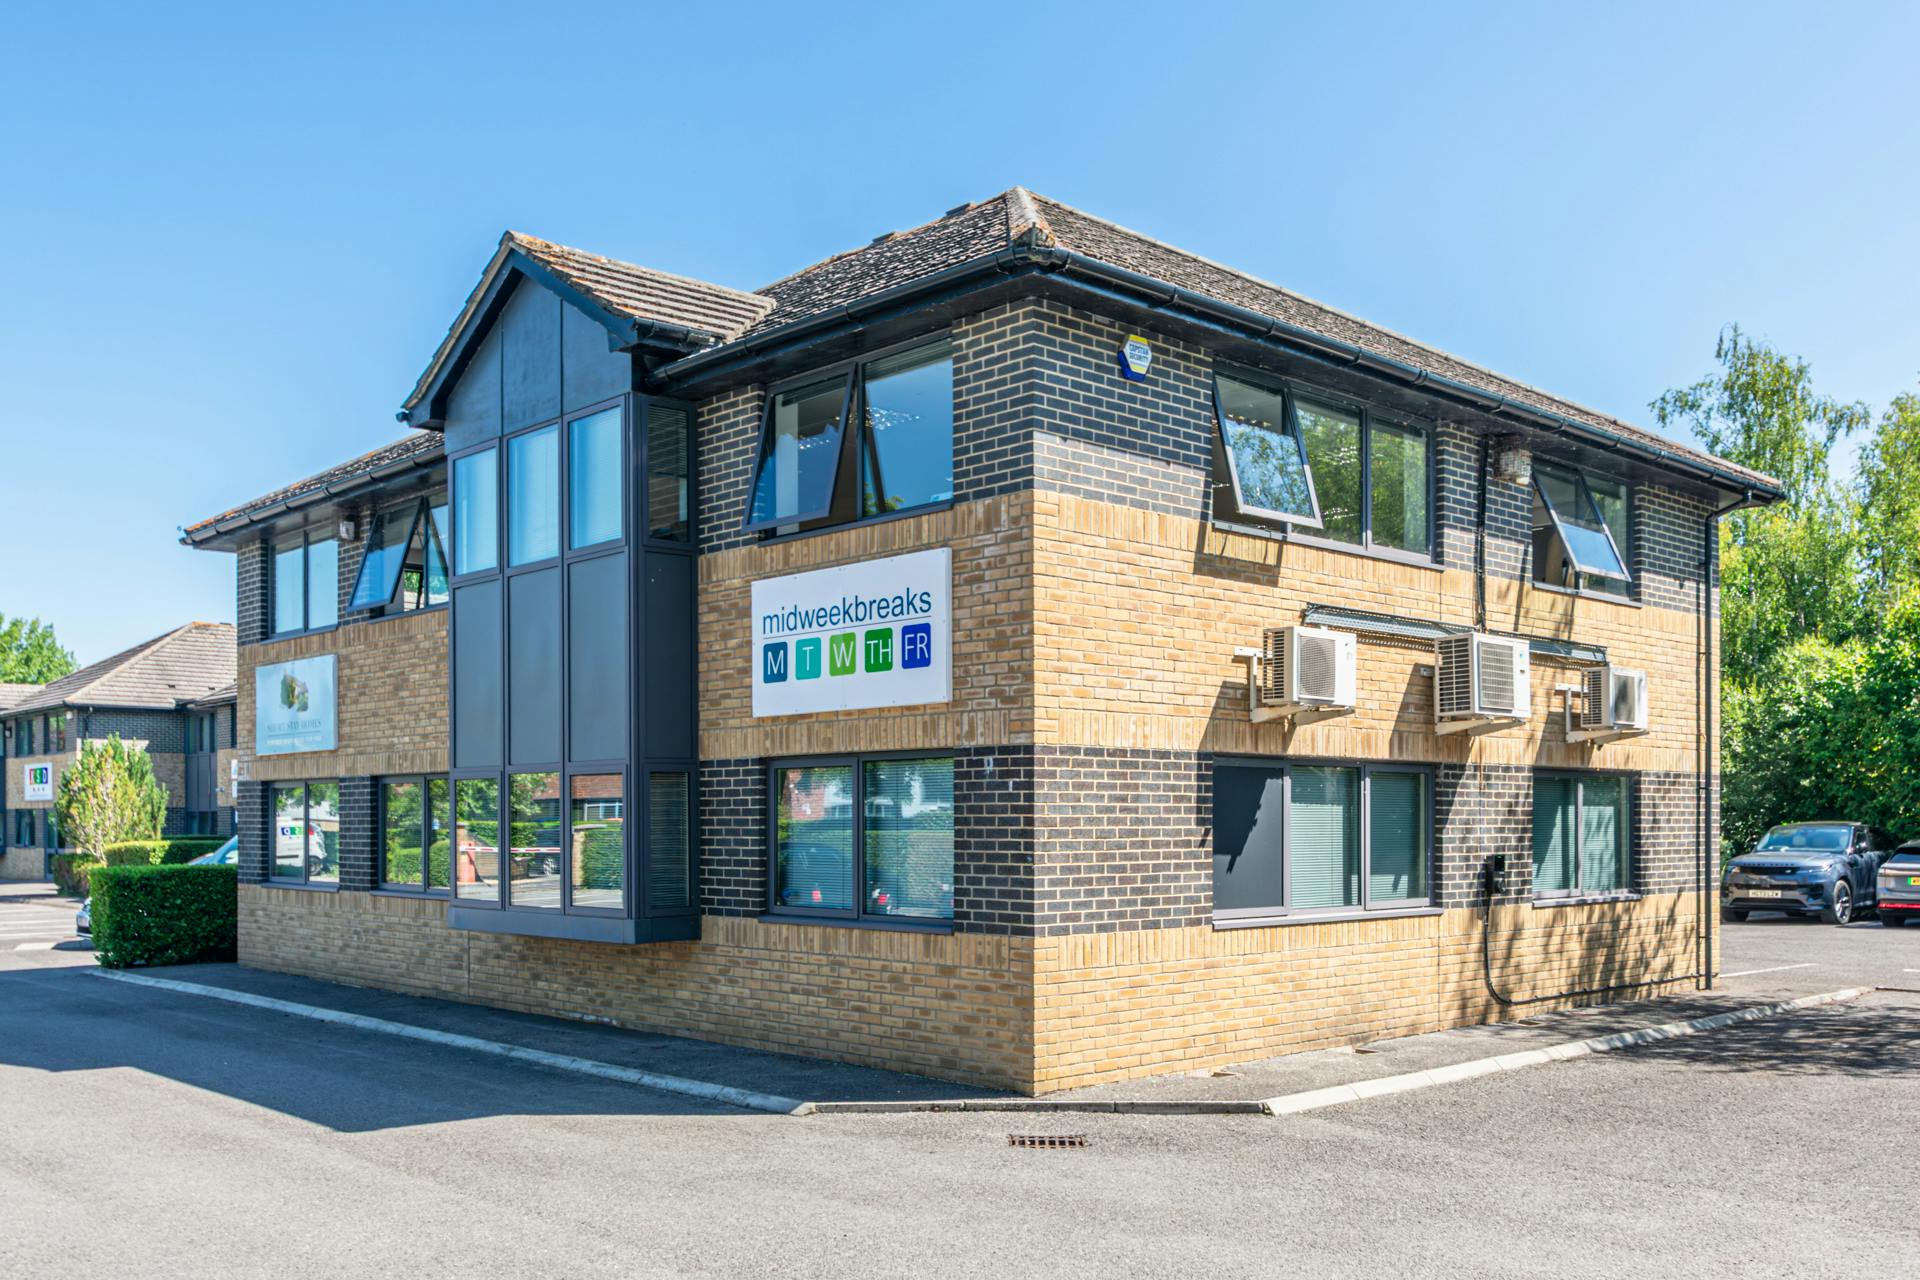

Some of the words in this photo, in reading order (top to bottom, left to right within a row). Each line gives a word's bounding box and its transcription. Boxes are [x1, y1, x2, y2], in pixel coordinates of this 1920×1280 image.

[763, 587, 931, 635] midweekbreaks
[767, 649, 784, 676] M
[802, 646, 814, 672] T
[832, 641, 854, 669] W
[866, 638, 892, 664] TH
[904, 632, 929, 661] FR
